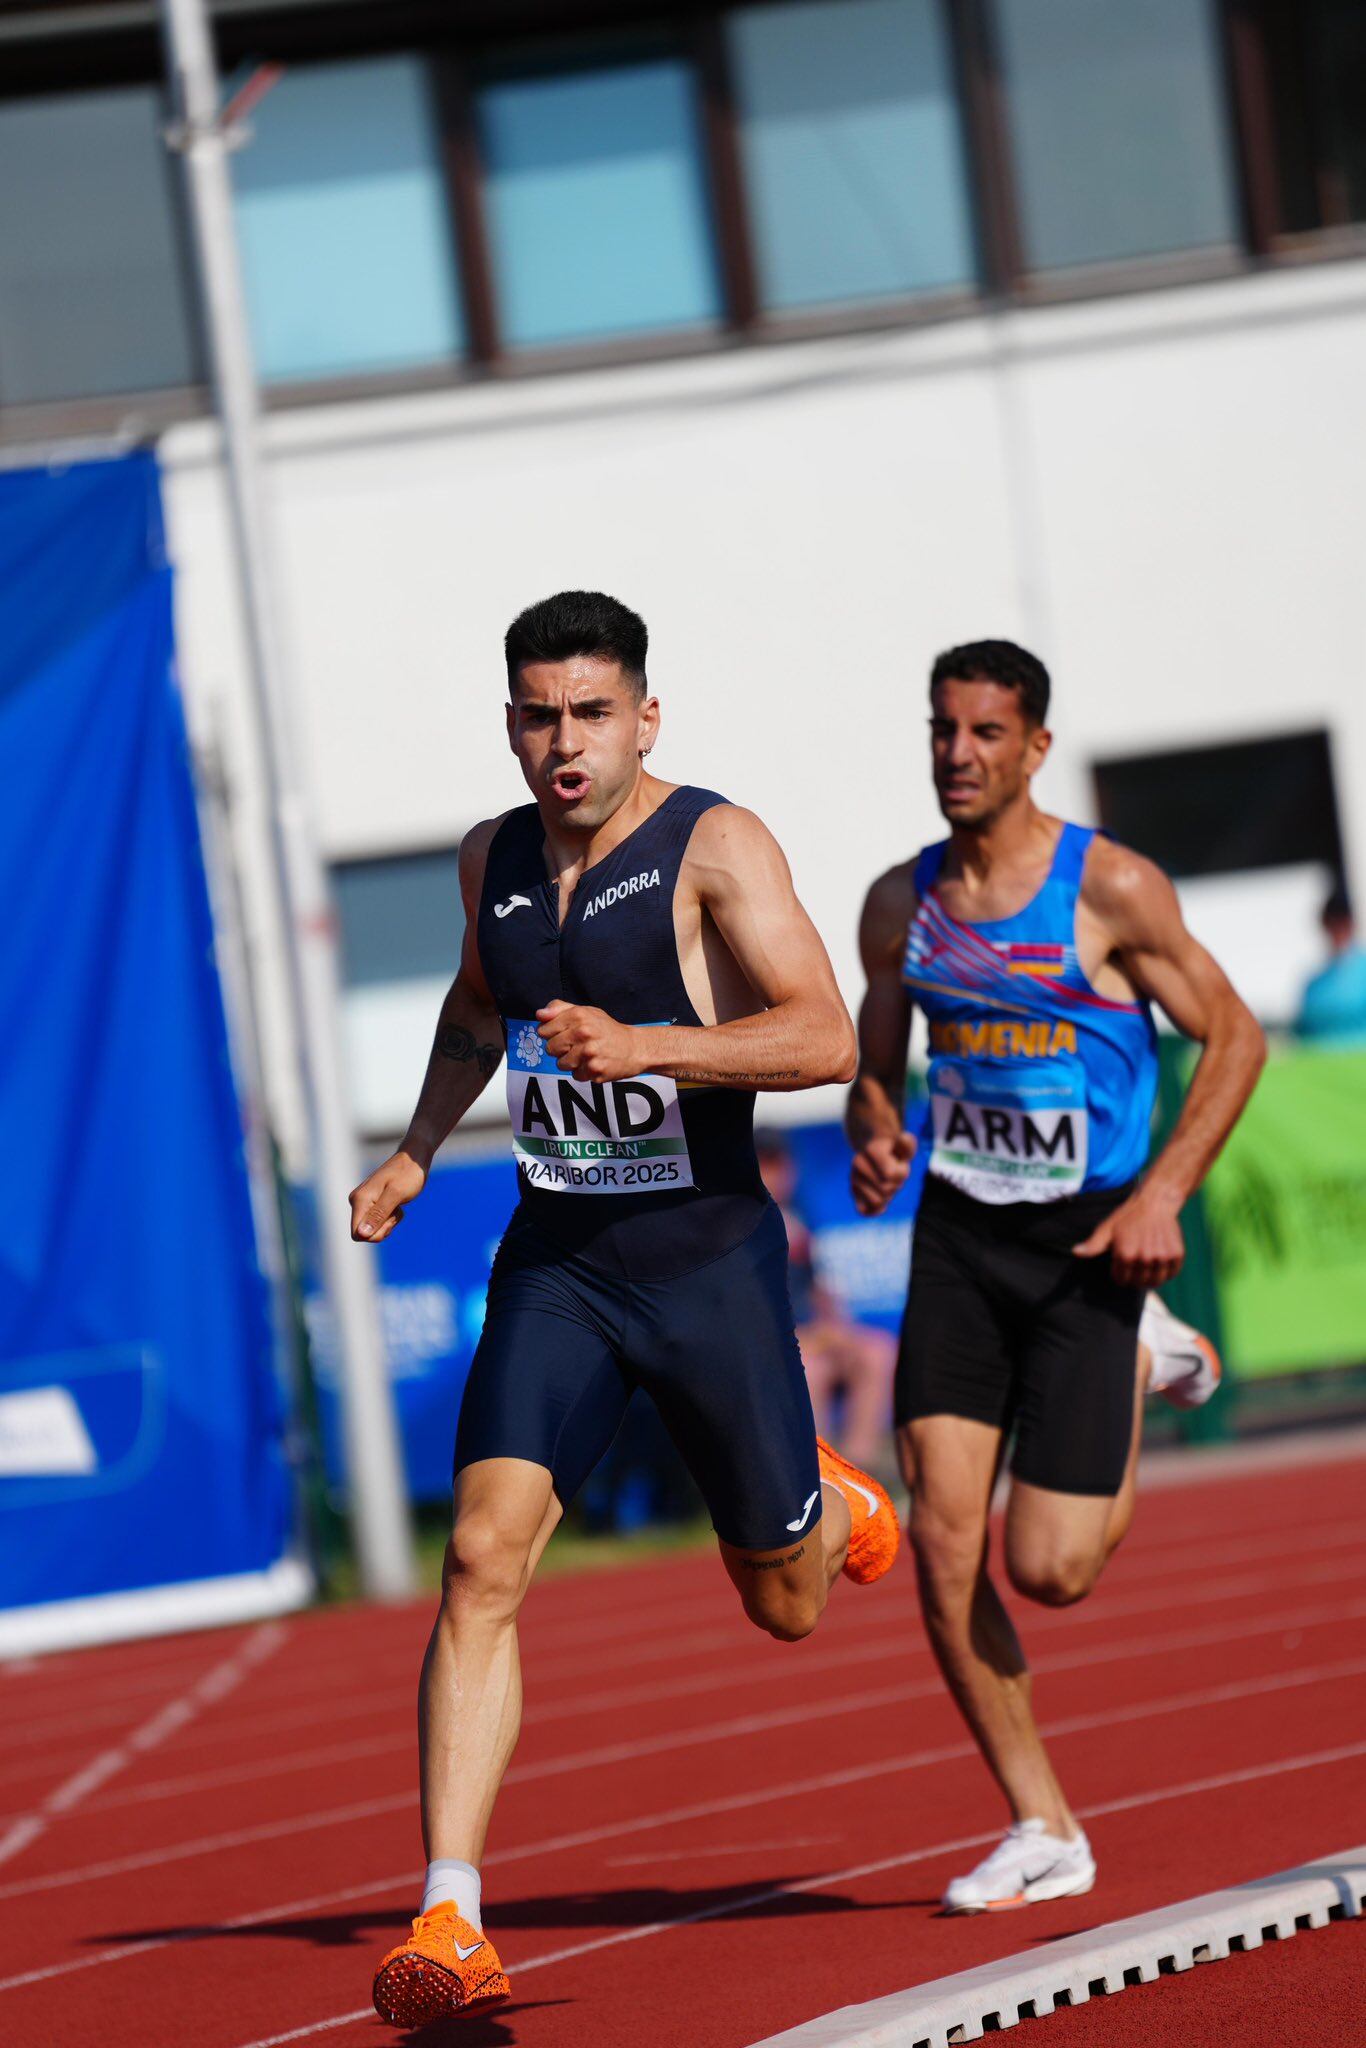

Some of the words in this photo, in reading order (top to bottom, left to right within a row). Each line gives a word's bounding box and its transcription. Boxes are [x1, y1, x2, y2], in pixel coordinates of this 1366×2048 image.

[583, 869, 661, 921] ANDORRA
[522, 1076, 666, 1139] AND
[945, 1101, 1076, 1161] ARM
[520, 1161, 617, 1186] MARIBOR
[622, 1162, 679, 1185] 2025
